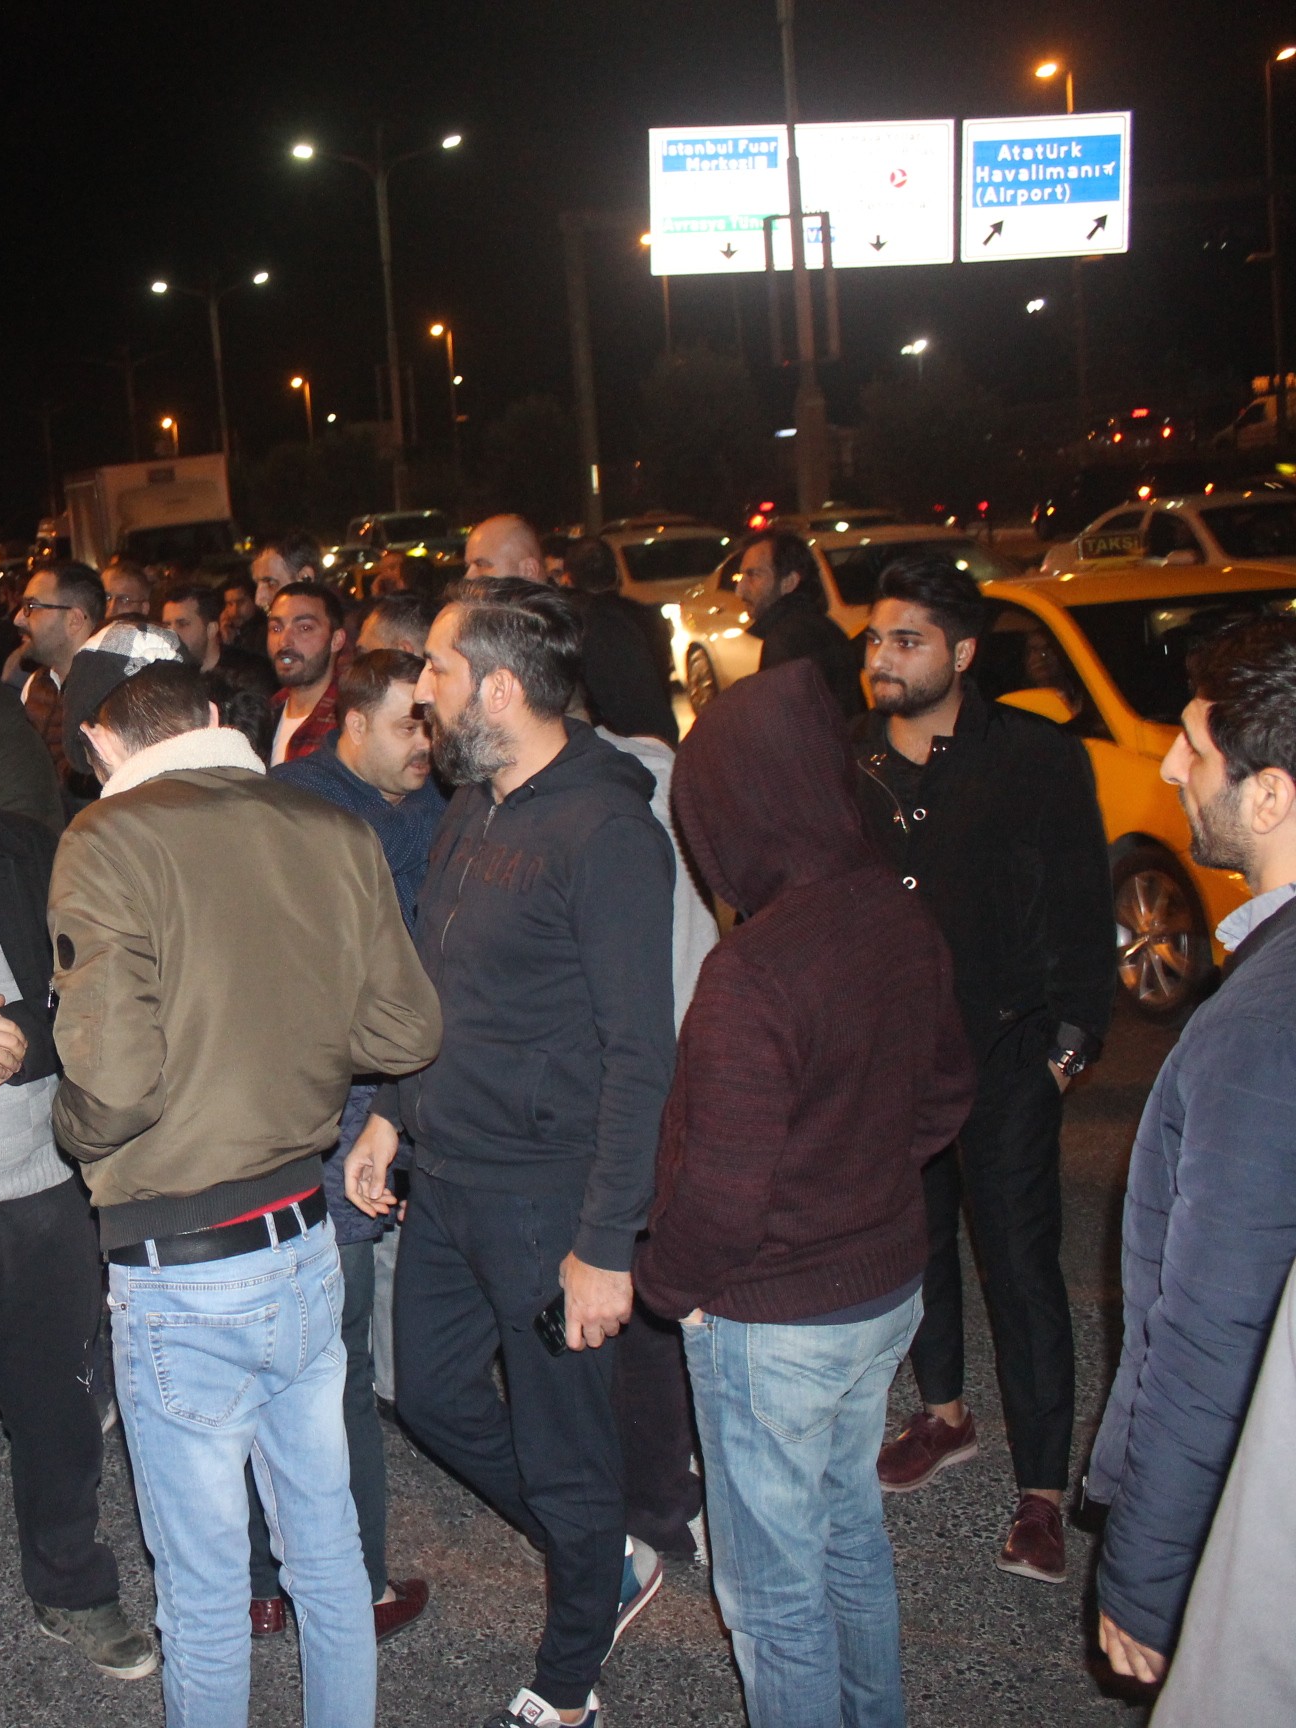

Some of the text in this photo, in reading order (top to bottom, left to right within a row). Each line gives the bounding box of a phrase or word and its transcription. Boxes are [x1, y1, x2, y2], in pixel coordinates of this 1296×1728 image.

[738, 138, 777, 153] Fuar
[997, 141, 1082, 161] Atatürk
[975, 184, 1070, 206] (Airport)
